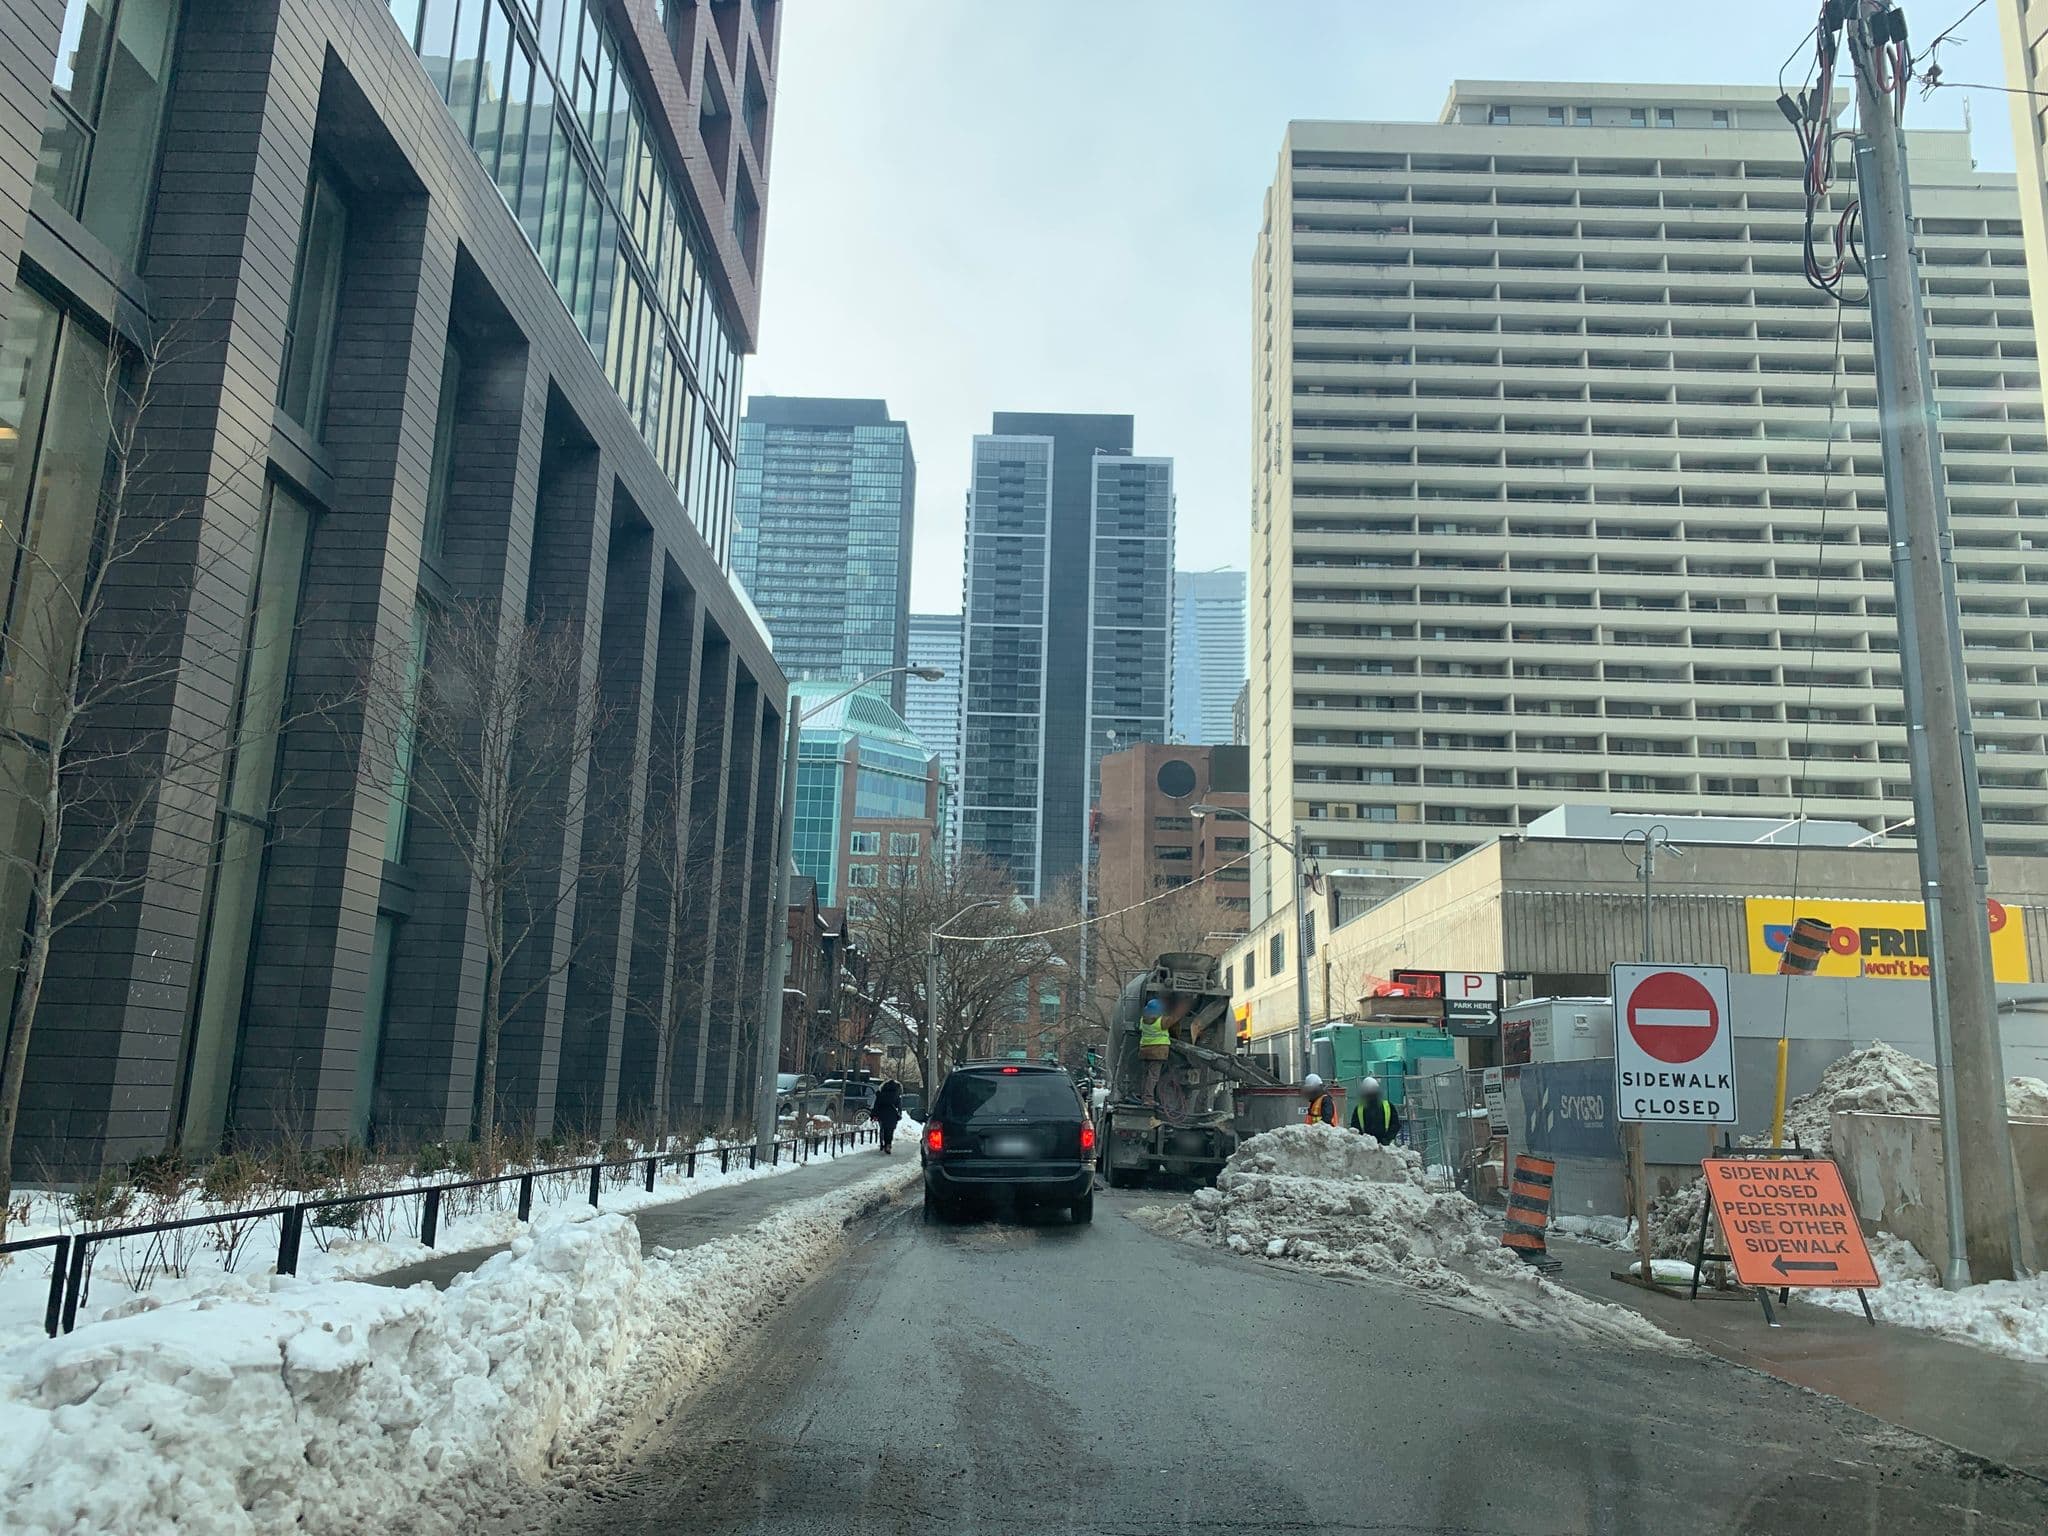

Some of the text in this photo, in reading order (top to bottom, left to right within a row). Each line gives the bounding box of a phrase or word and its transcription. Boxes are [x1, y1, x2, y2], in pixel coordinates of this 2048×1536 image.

[1865, 960, 1906, 975] won't
[1464, 974, 1482, 997] P
[1622, 1071, 1730, 1089] SIDEWALK
[1634, 1098, 1720, 1115] CLOSED
[1719, 1166, 1820, 1181] SIDEWALK
[1738, 1184, 1818, 1199] CLOSED
[1723, 1201, 1847, 1217] PEDESTRIAN
[1734, 1220, 1848, 1235] USE OTHER
[1745, 1238, 1850, 1255] SIDEWALK
